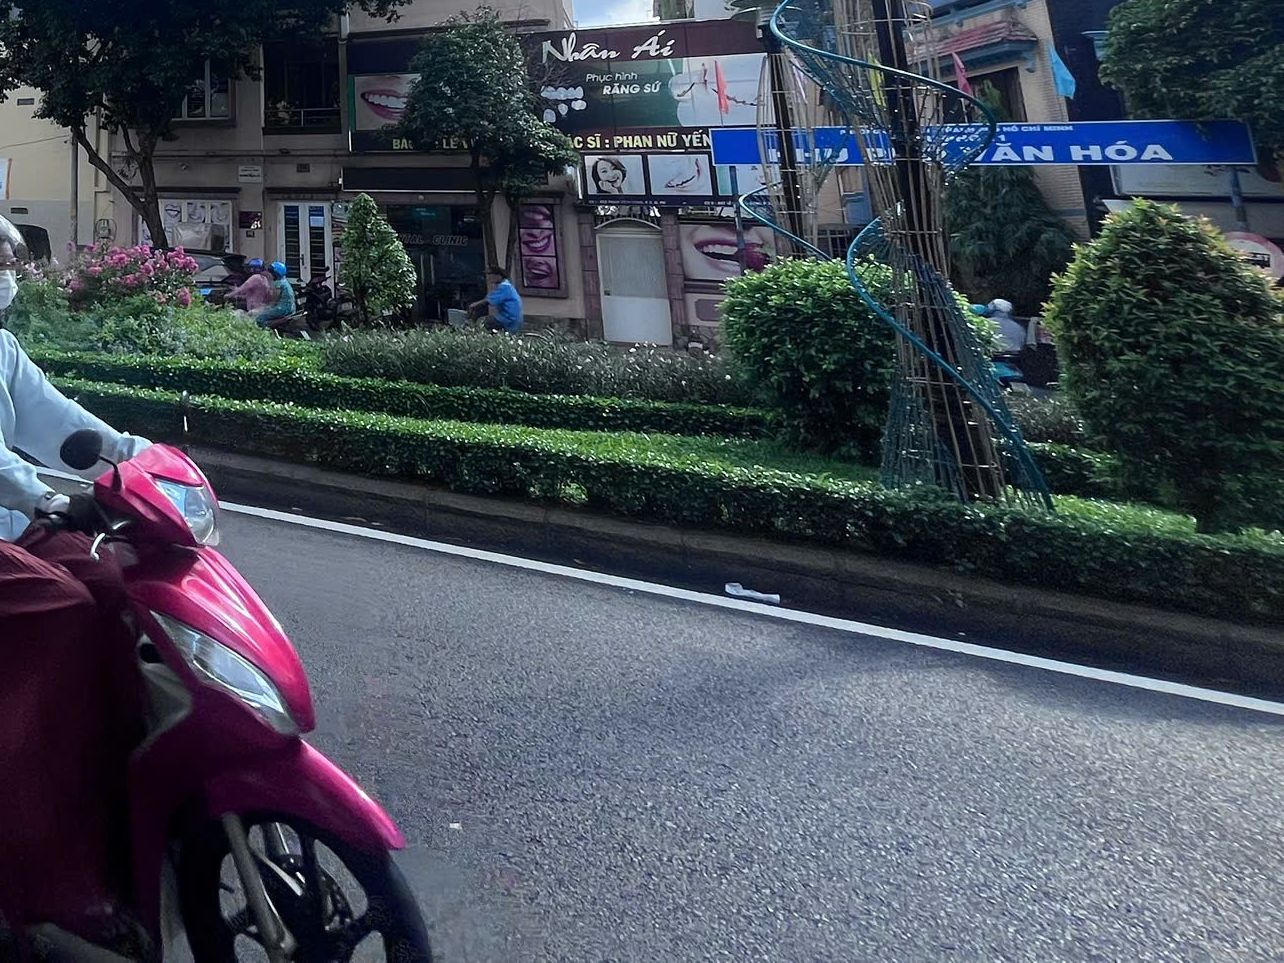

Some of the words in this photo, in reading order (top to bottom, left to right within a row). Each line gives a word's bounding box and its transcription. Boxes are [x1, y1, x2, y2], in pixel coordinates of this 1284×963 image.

[542, 32, 621, 64] Nhân
[631, 29, 676, 59] Ái
[585, 73, 613, 83] Phục
[614, 71, 638, 82] hình
[602, 82, 640, 95] RĂNG
[643, 81, 662, 94] SỨ
[586, 133, 601, 149] SĨ
[613, 135, 653, 149] PHAN
[656, 131, 678, 148] NỮ
[1069, 141, 1174, 161] HÓA
